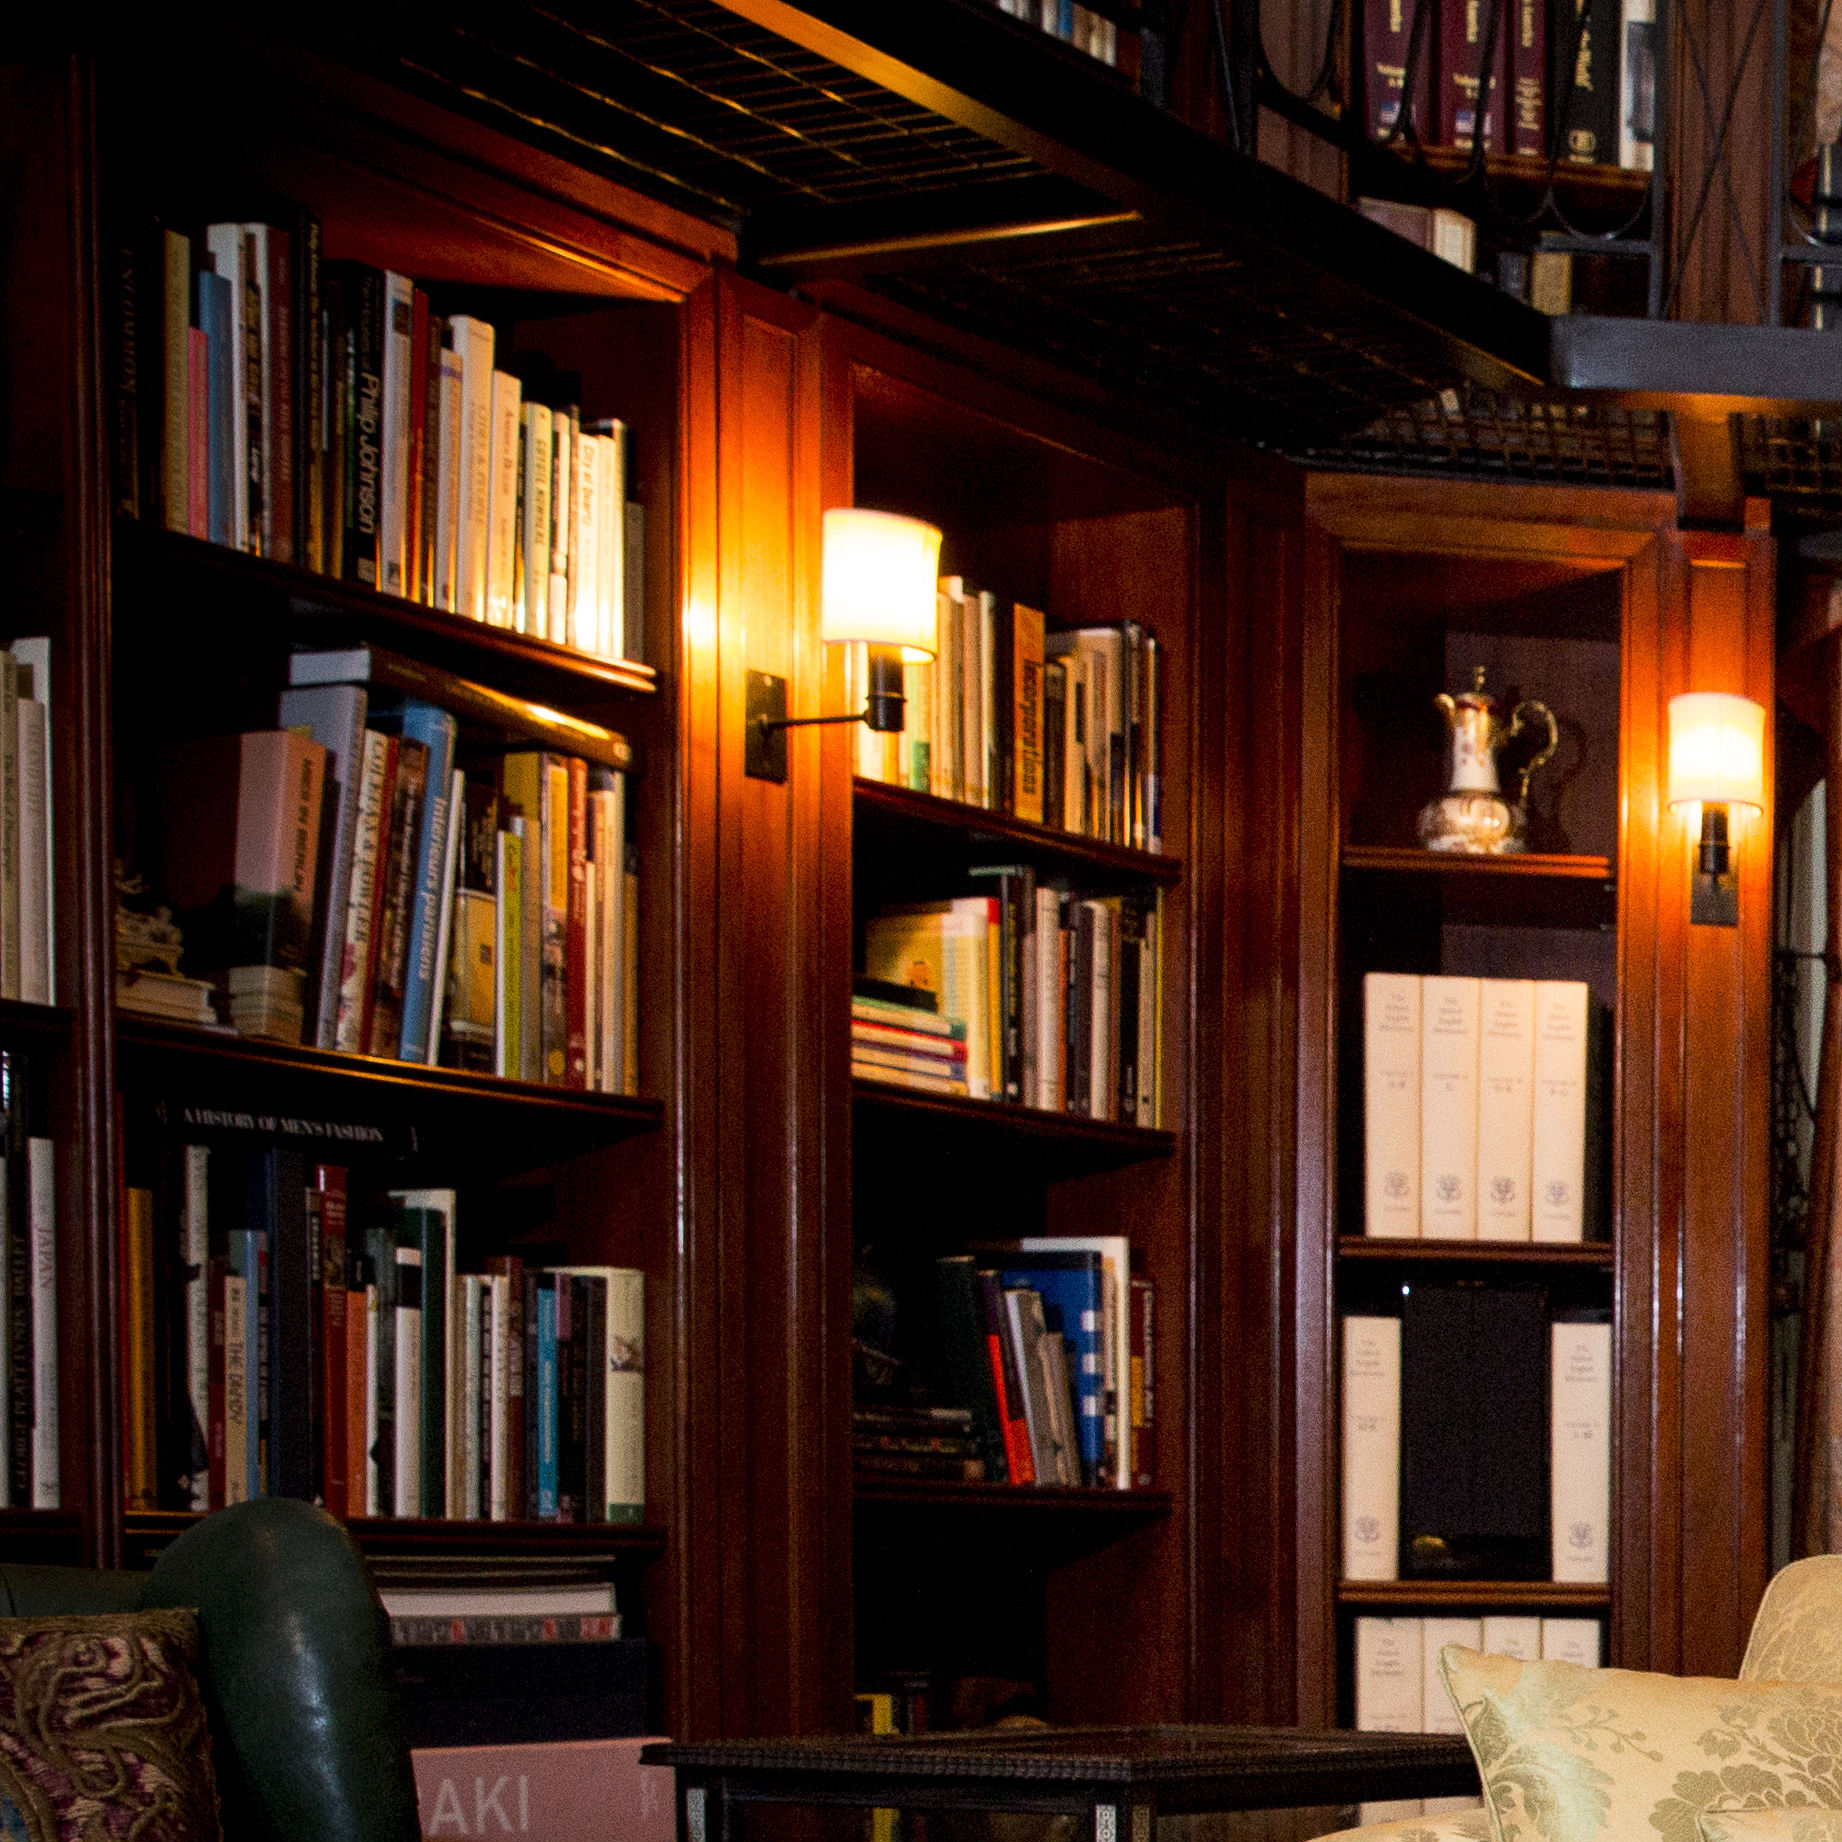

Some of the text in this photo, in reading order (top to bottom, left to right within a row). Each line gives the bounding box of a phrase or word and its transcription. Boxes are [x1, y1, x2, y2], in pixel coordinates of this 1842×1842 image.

[356, 372, 380, 434] Philip
[358, 435, 380, 536] Johnson
[1019, 659, 1043, 796] Incorporations
[419, 892, 439, 981] parisiens
[195, 1107, 256, 1131] HISTORY
[257, 1115, 277, 1133] OF
[325, 1122, 385, 1143] FASHION
[36, 1227, 54, 1288] JAPAN
[228, 1342, 244, 1425] THE DANDY
